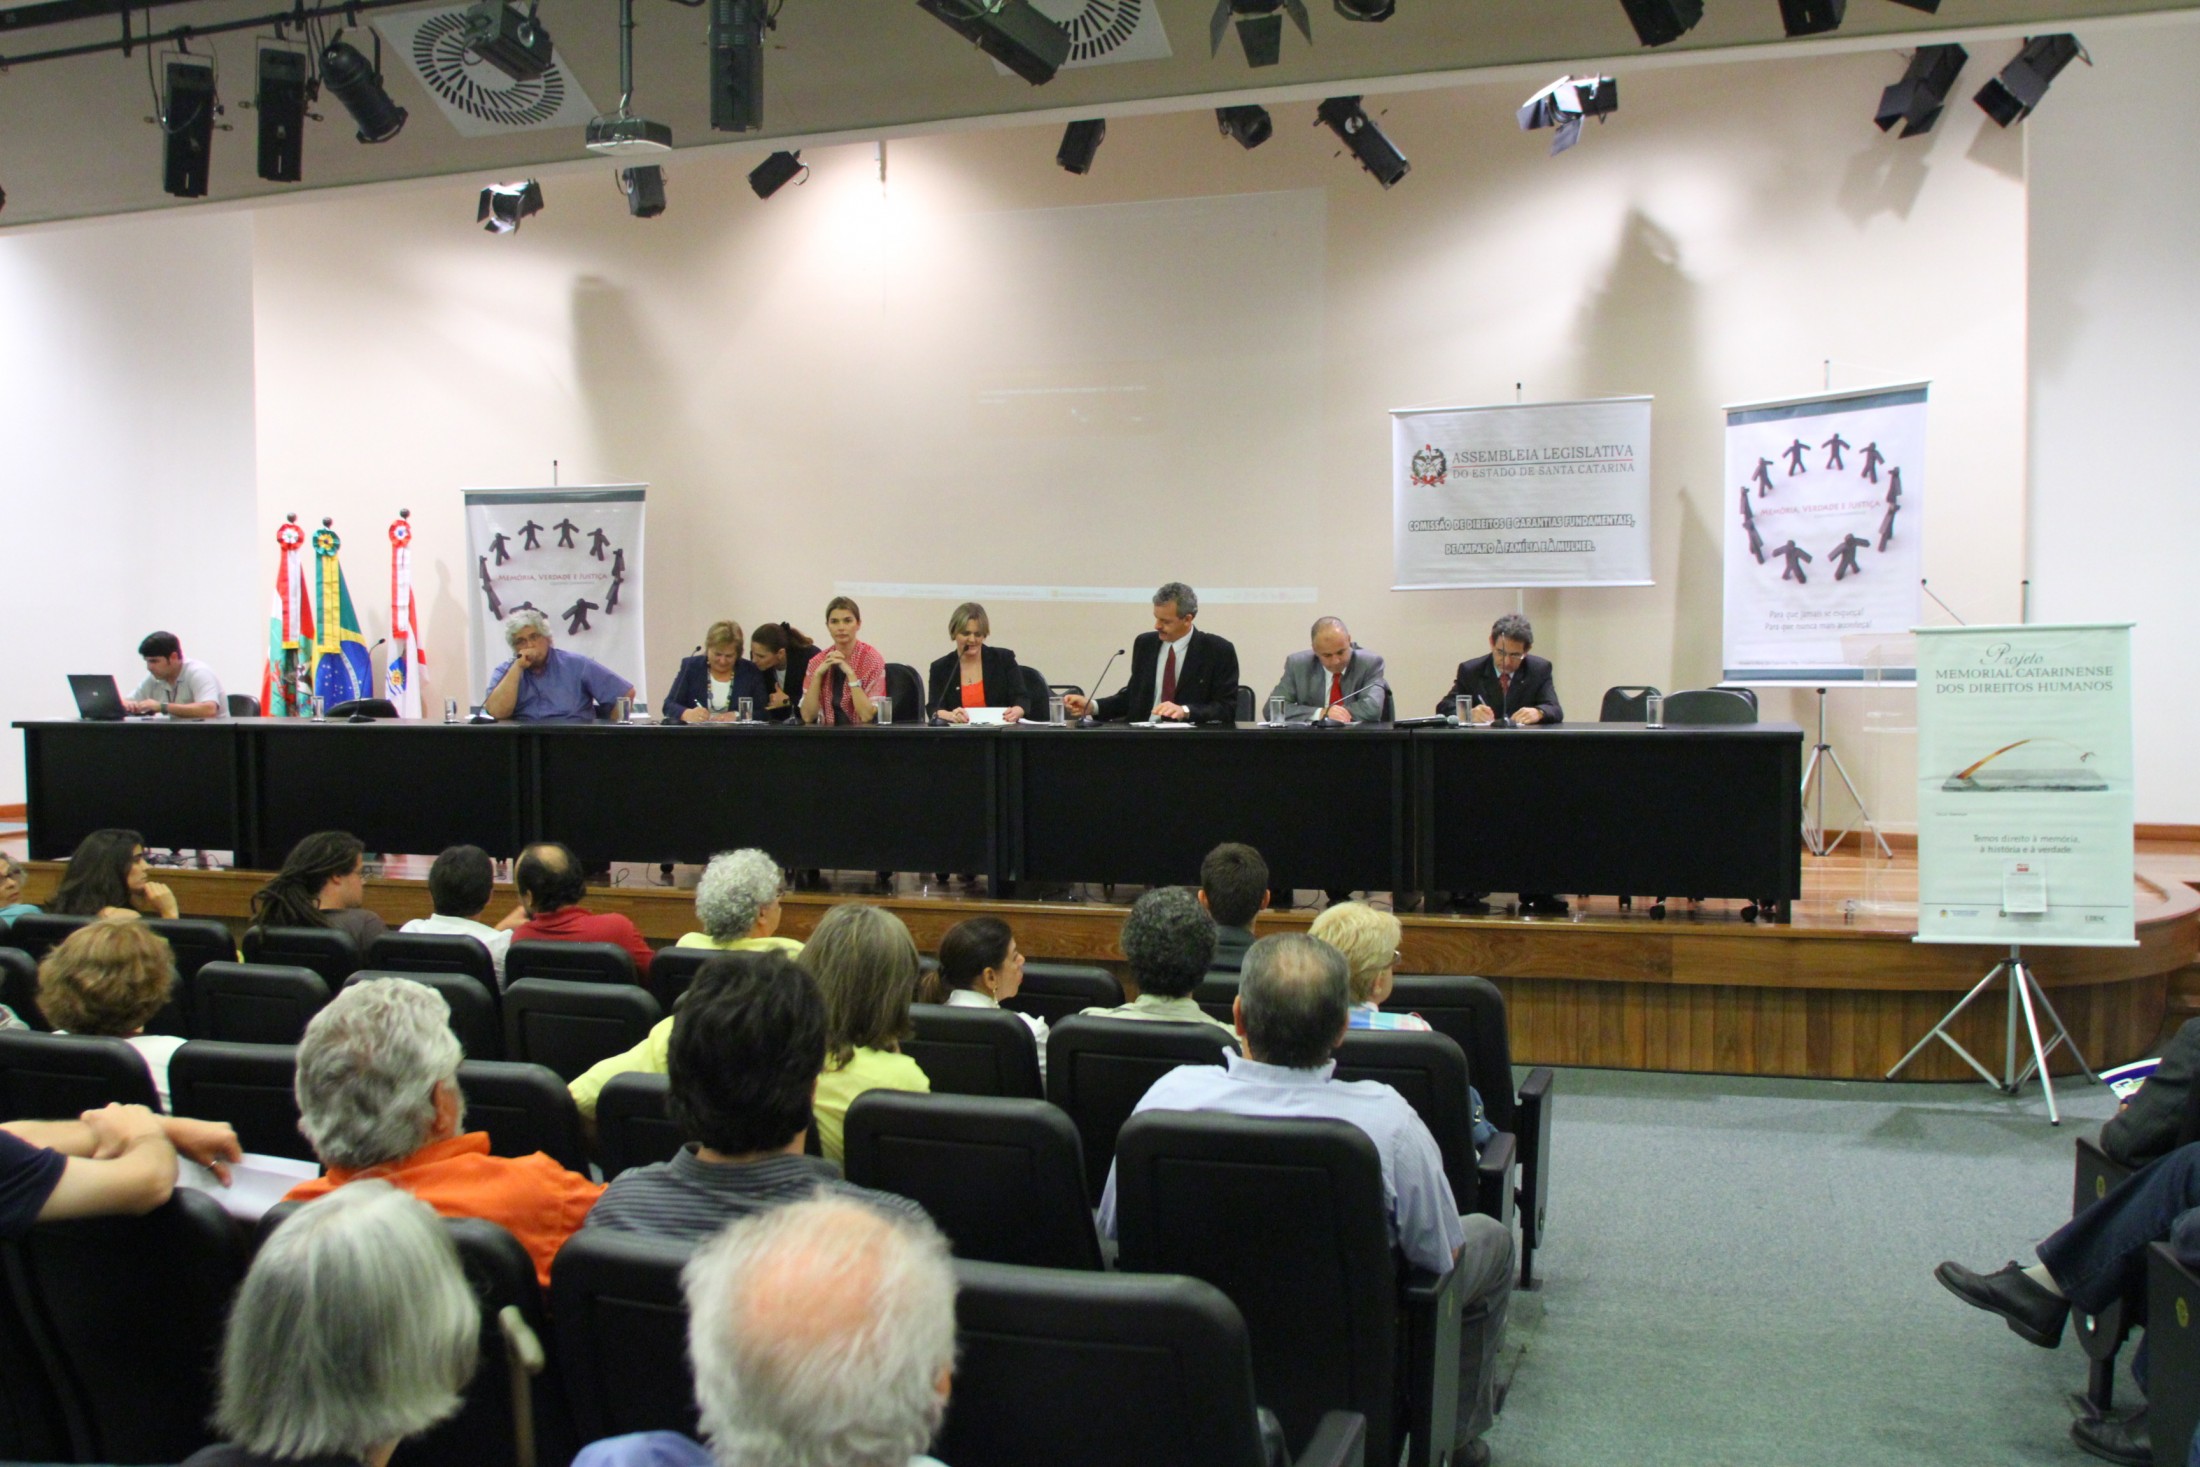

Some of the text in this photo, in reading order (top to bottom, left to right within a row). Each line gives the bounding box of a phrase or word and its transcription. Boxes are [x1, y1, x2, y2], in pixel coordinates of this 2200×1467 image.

[1452, 444, 1634, 464] ASSEMBLEIA LEGISLATIVA
[1453, 462, 1635, 479] DO ESTADO DE SANTA CATARINA
[1802, 503, 1839, 513] VERDADE
[1408, 513, 1636, 532] COMISSÃO DE DIREITOS E GARANTIAS FUNDAMENTAIS,
[1445, 543, 1457, 555] DE
[1457, 542, 1494, 554] AMPARO
[1496, 539, 1504, 554] À
[1504, 538, 1540, 553] FAMÍLIA
[1540, 541, 1547, 552] E
[1556, 540, 1596, 552] MULHER.
[1979, 642, 2044, 669] Projeto
[1935, 665, 2114, 679] MEMORIAL CATARINENSE
[1936, 680, 2114, 694] DOS DIREITOS HUMANOS
[1973, 834, 1999, 843] Temos
[2000, 834, 2031, 843] direito
